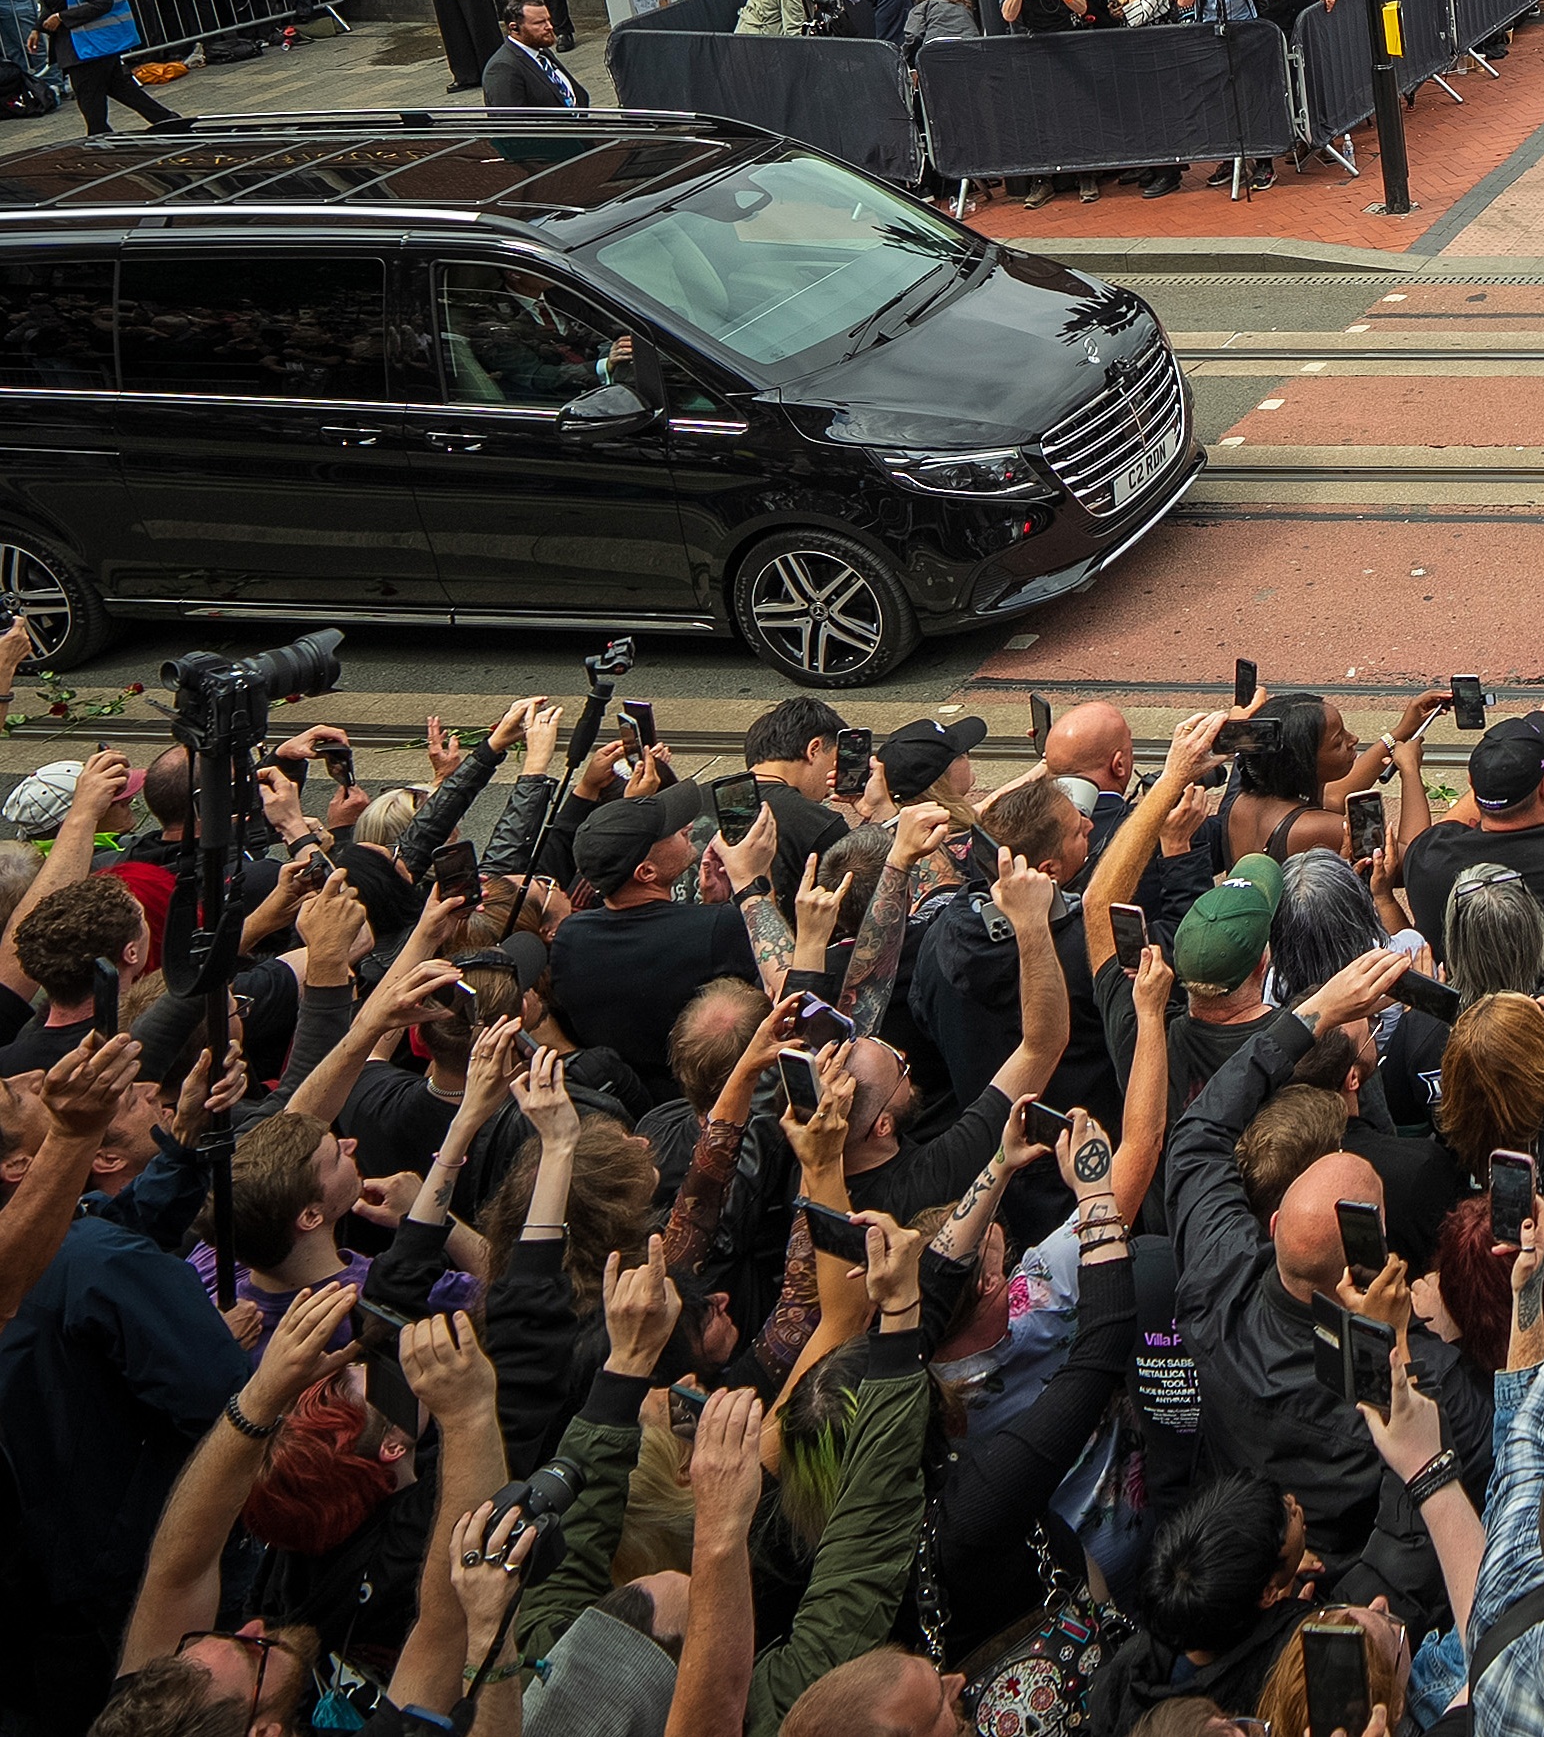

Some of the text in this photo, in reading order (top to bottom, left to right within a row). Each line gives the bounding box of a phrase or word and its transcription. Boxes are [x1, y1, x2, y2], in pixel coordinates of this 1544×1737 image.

[1128, 440, 1167, 490] C2 RDN
[1144, 1332, 1171, 1346] Villa
[1136, 1356, 1195, 1368] BLACK SABB
[1139, 1368, 1186, 1379] METALLICA
[1161, 1379, 1187, 1388] TOOL
